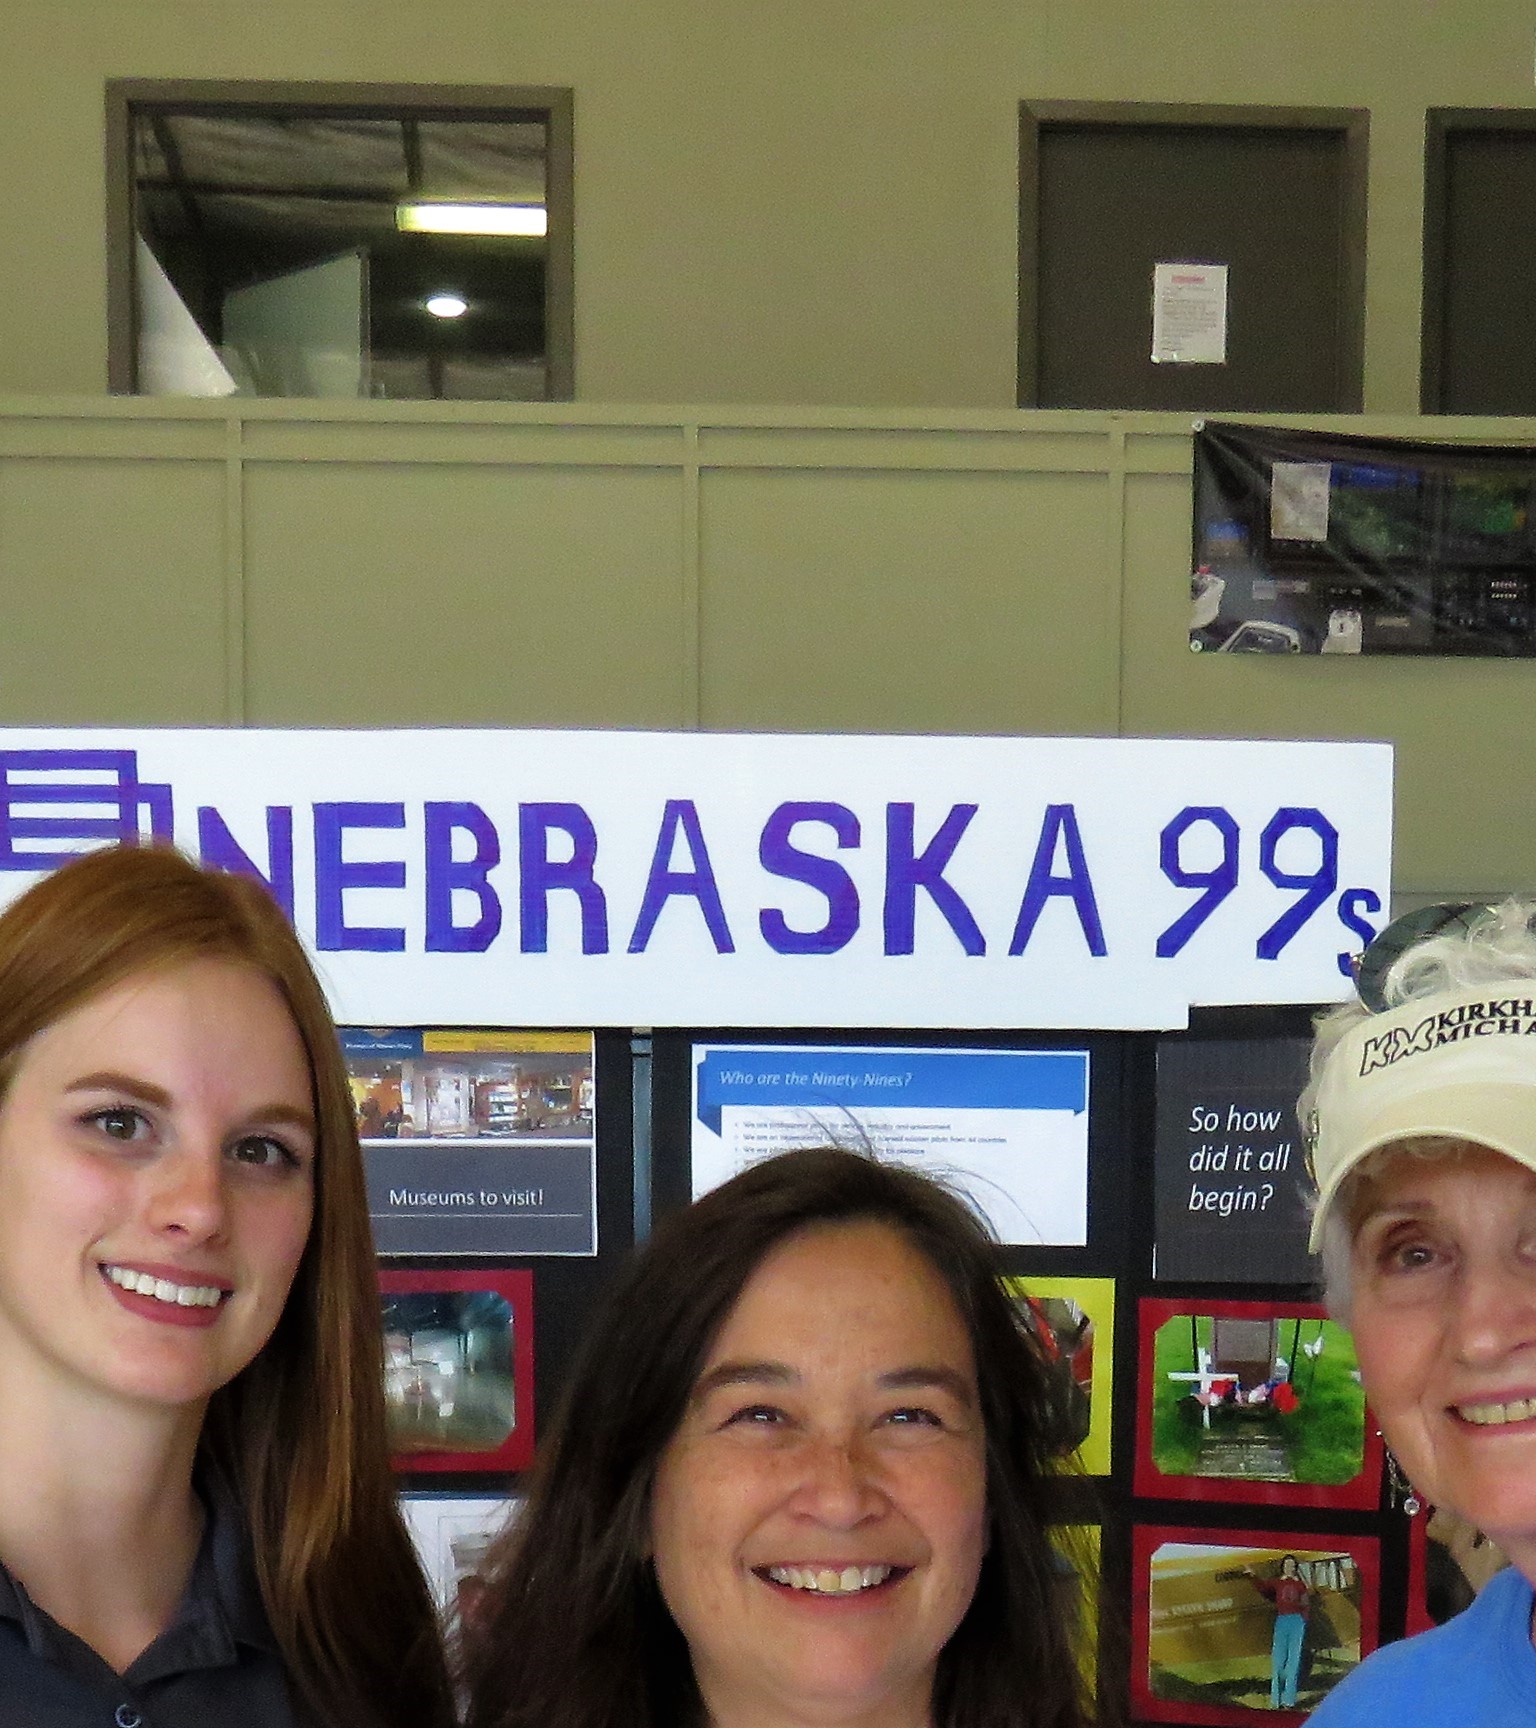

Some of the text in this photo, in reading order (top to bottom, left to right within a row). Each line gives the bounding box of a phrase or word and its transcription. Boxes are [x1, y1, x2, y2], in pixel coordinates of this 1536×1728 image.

[198, 798, 1109, 959] NEBRASKA
[719, 1071, 912, 1090] Who are the Ninety-Nines?
[1188, 1103, 1282, 1133] So how
[1189, 1143, 1291, 1172] did it all
[389, 1189, 544, 1207] Museums to visit!
[1188, 1182, 1274, 1218] begin?
